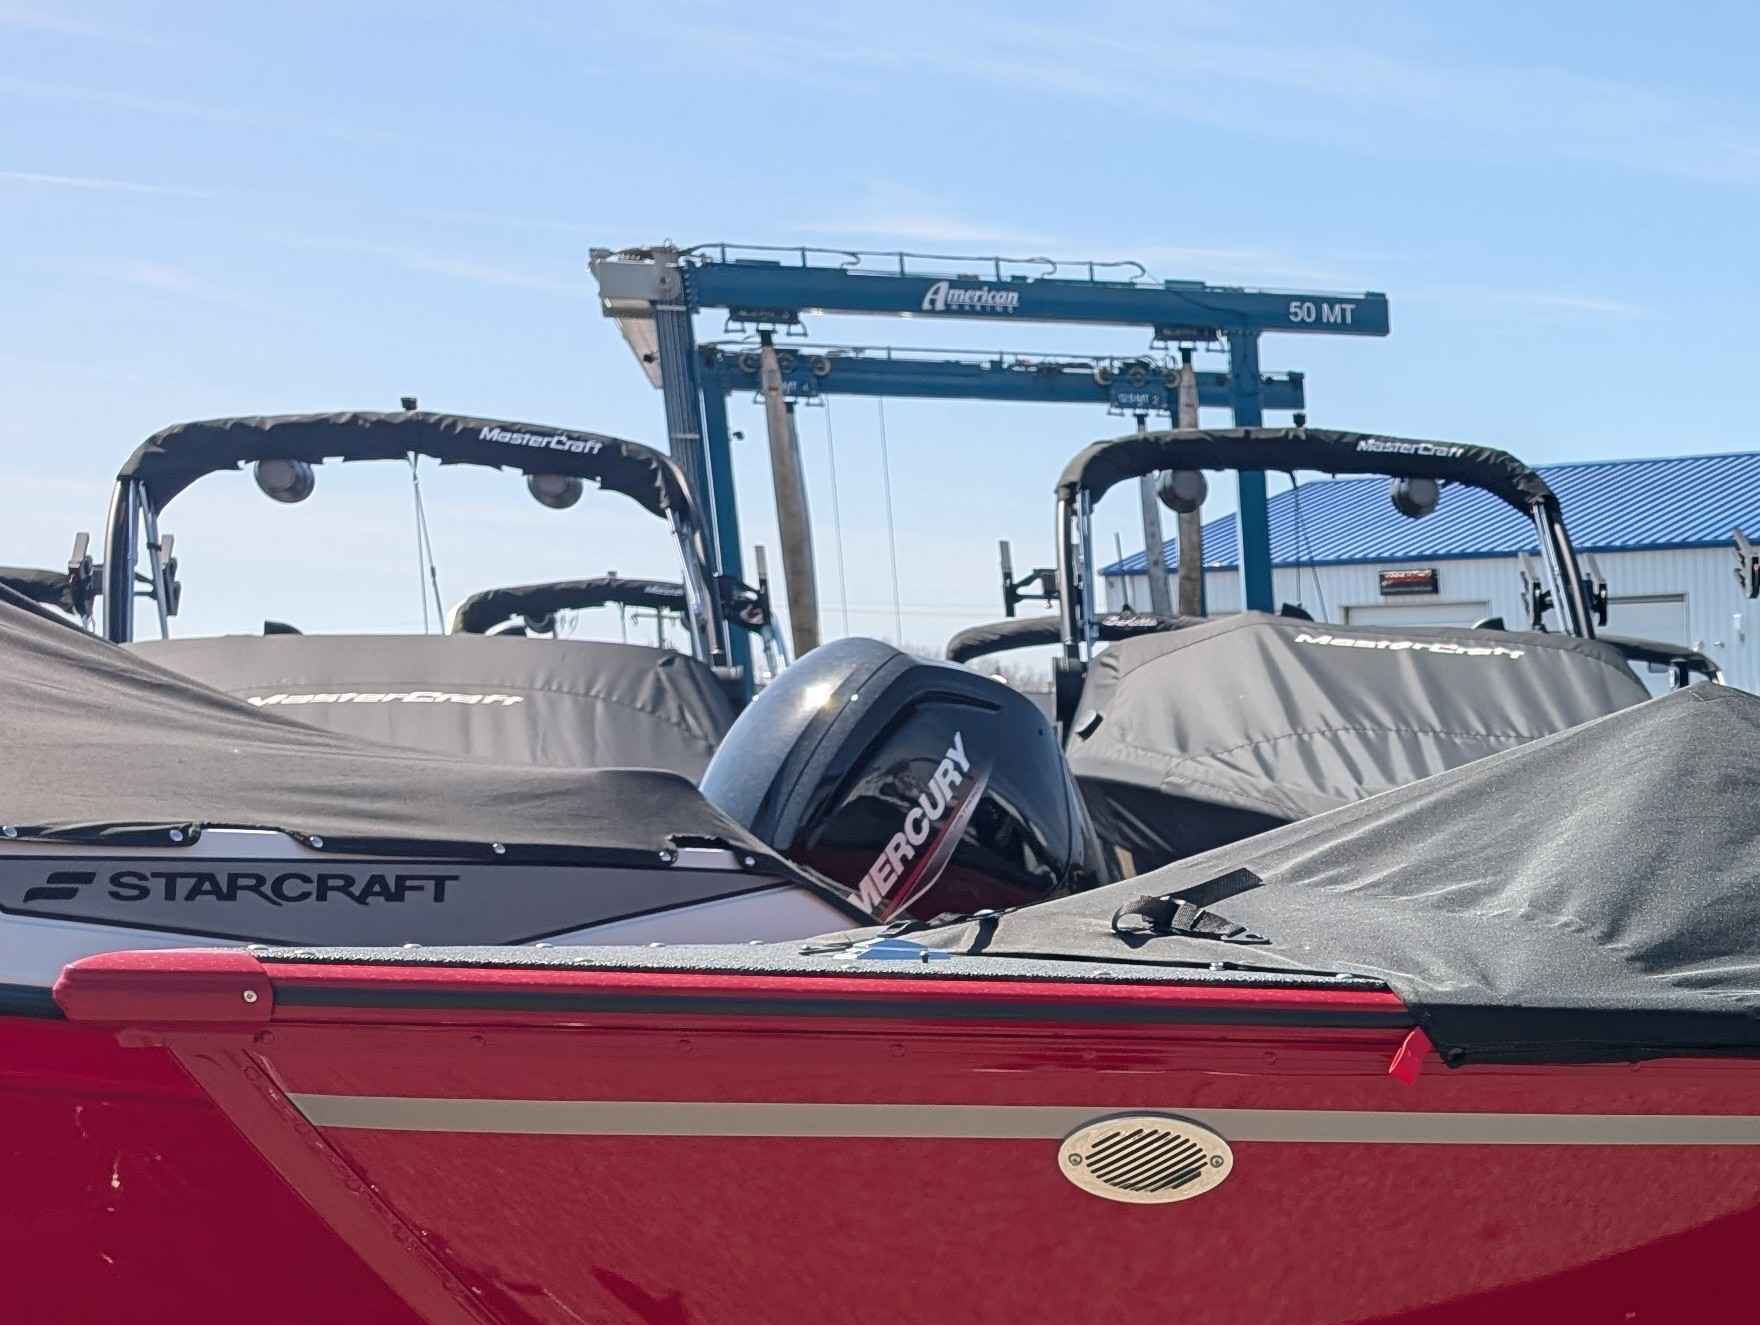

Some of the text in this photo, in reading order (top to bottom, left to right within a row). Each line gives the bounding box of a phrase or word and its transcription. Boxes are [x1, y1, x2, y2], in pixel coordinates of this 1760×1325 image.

[920, 281, 1019, 311] American
[1289, 302, 1356, 325] 50 MT
[479, 426, 602, 455] MasterCraft
[1356, 438, 1465, 458] MasterCraft
[1295, 633, 1525, 660] MasterCraft
[847, 731, 971, 914] MERCURY
[107, 870, 461, 907] STARCRAFT
